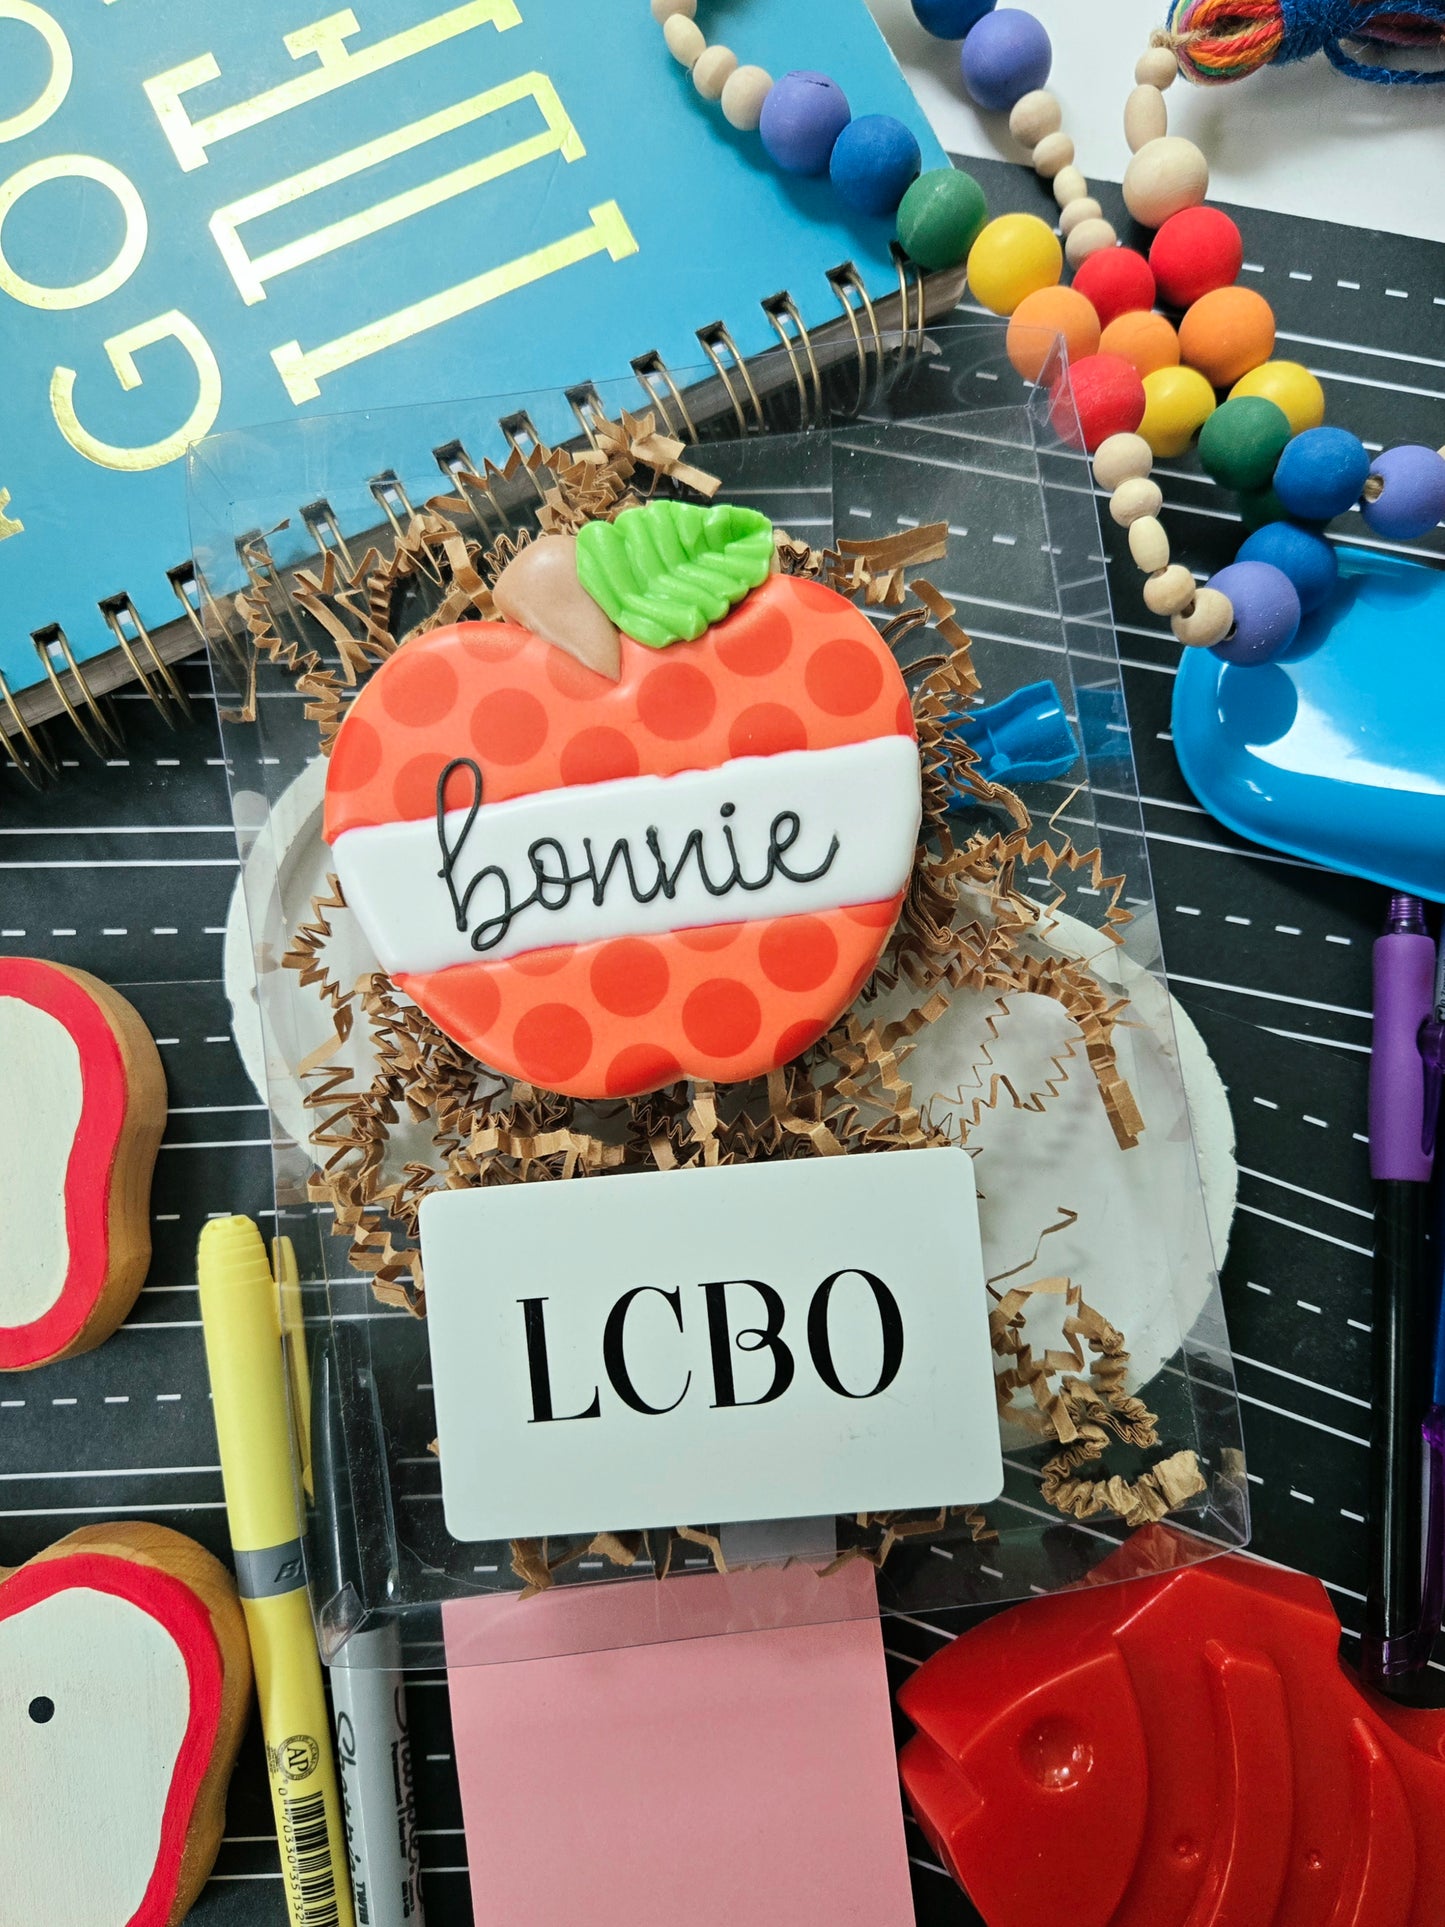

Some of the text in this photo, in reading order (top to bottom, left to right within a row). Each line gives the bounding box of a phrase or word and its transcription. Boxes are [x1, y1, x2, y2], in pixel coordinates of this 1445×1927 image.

[437, 757, 840, 951] bonnie
[516, 1268, 905, 1423] LCBO
[287, 1747, 309, 1772] AP
[281, 1815, 298, 1864] 70330
